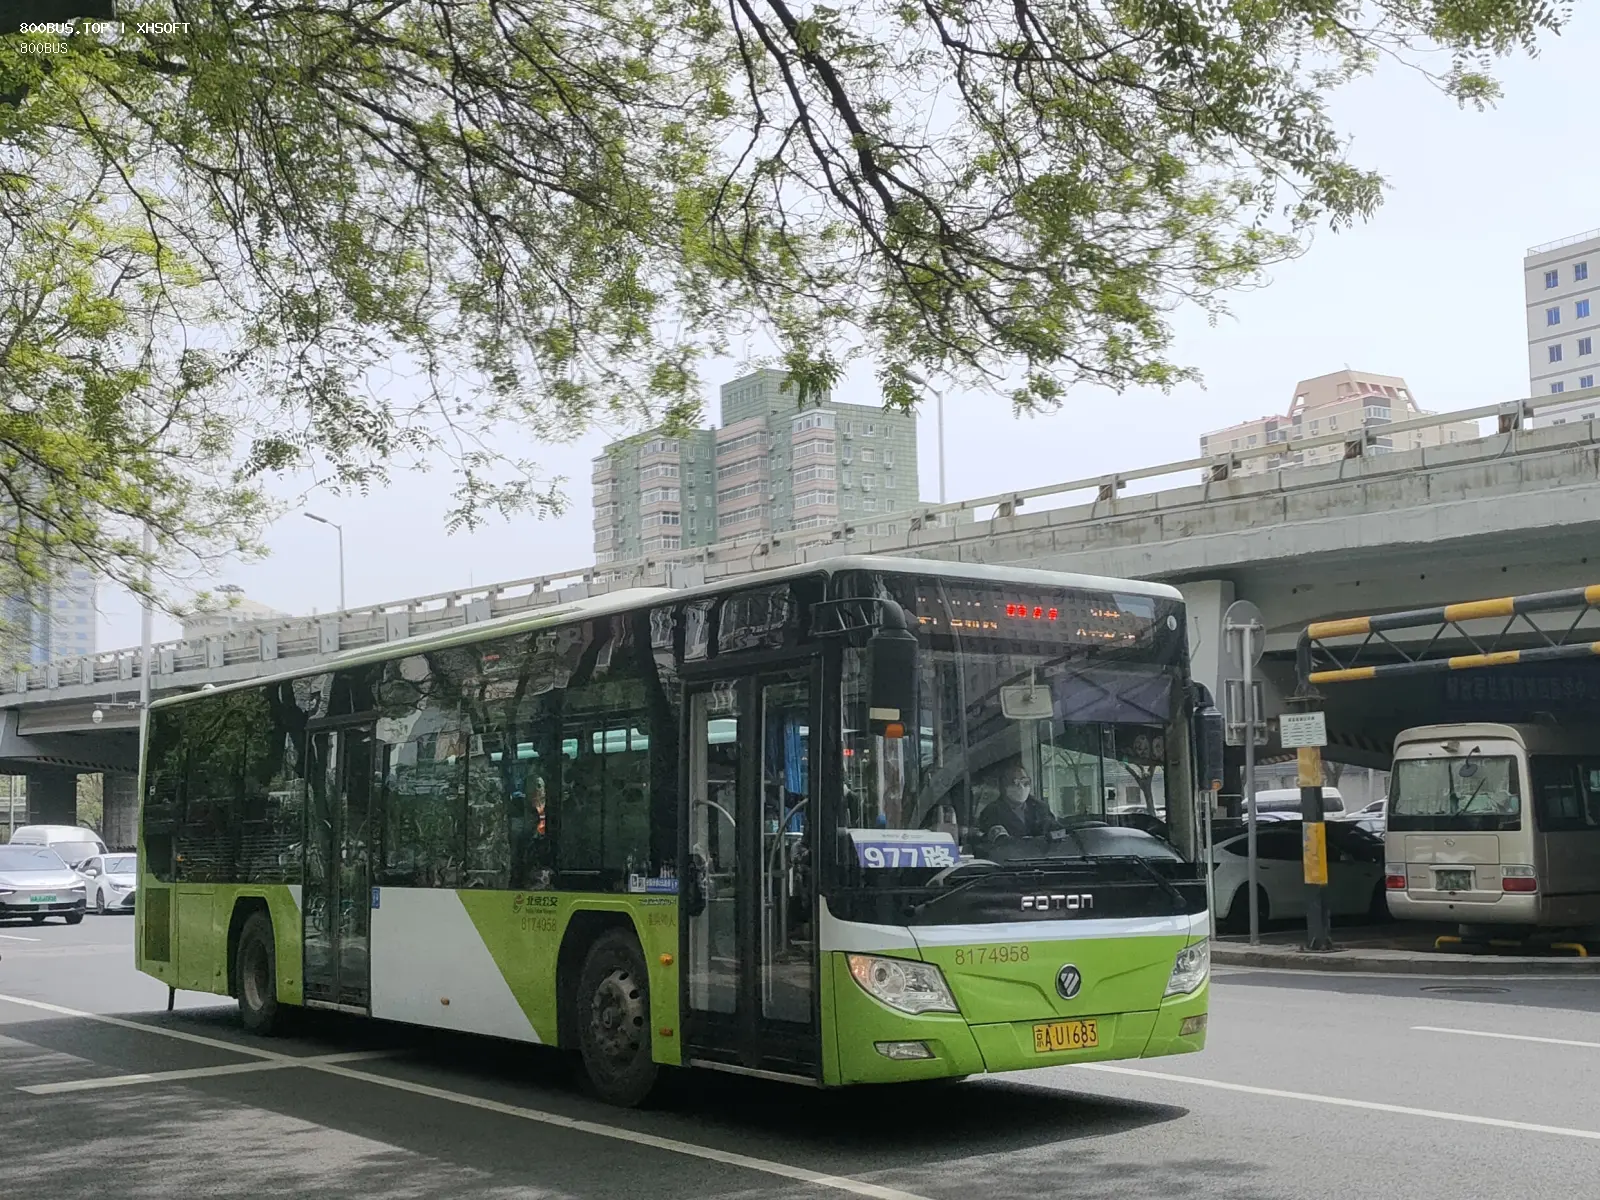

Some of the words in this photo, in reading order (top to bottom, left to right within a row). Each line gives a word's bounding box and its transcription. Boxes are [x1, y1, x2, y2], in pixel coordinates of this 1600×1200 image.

[864, 845, 954, 868] 977路
[526, 895, 558, 907] 北京公交
[1021, 894, 1094, 911] FOTON
[521, 917, 557, 932] 8174958
[955, 945, 1030, 966] 8174958
